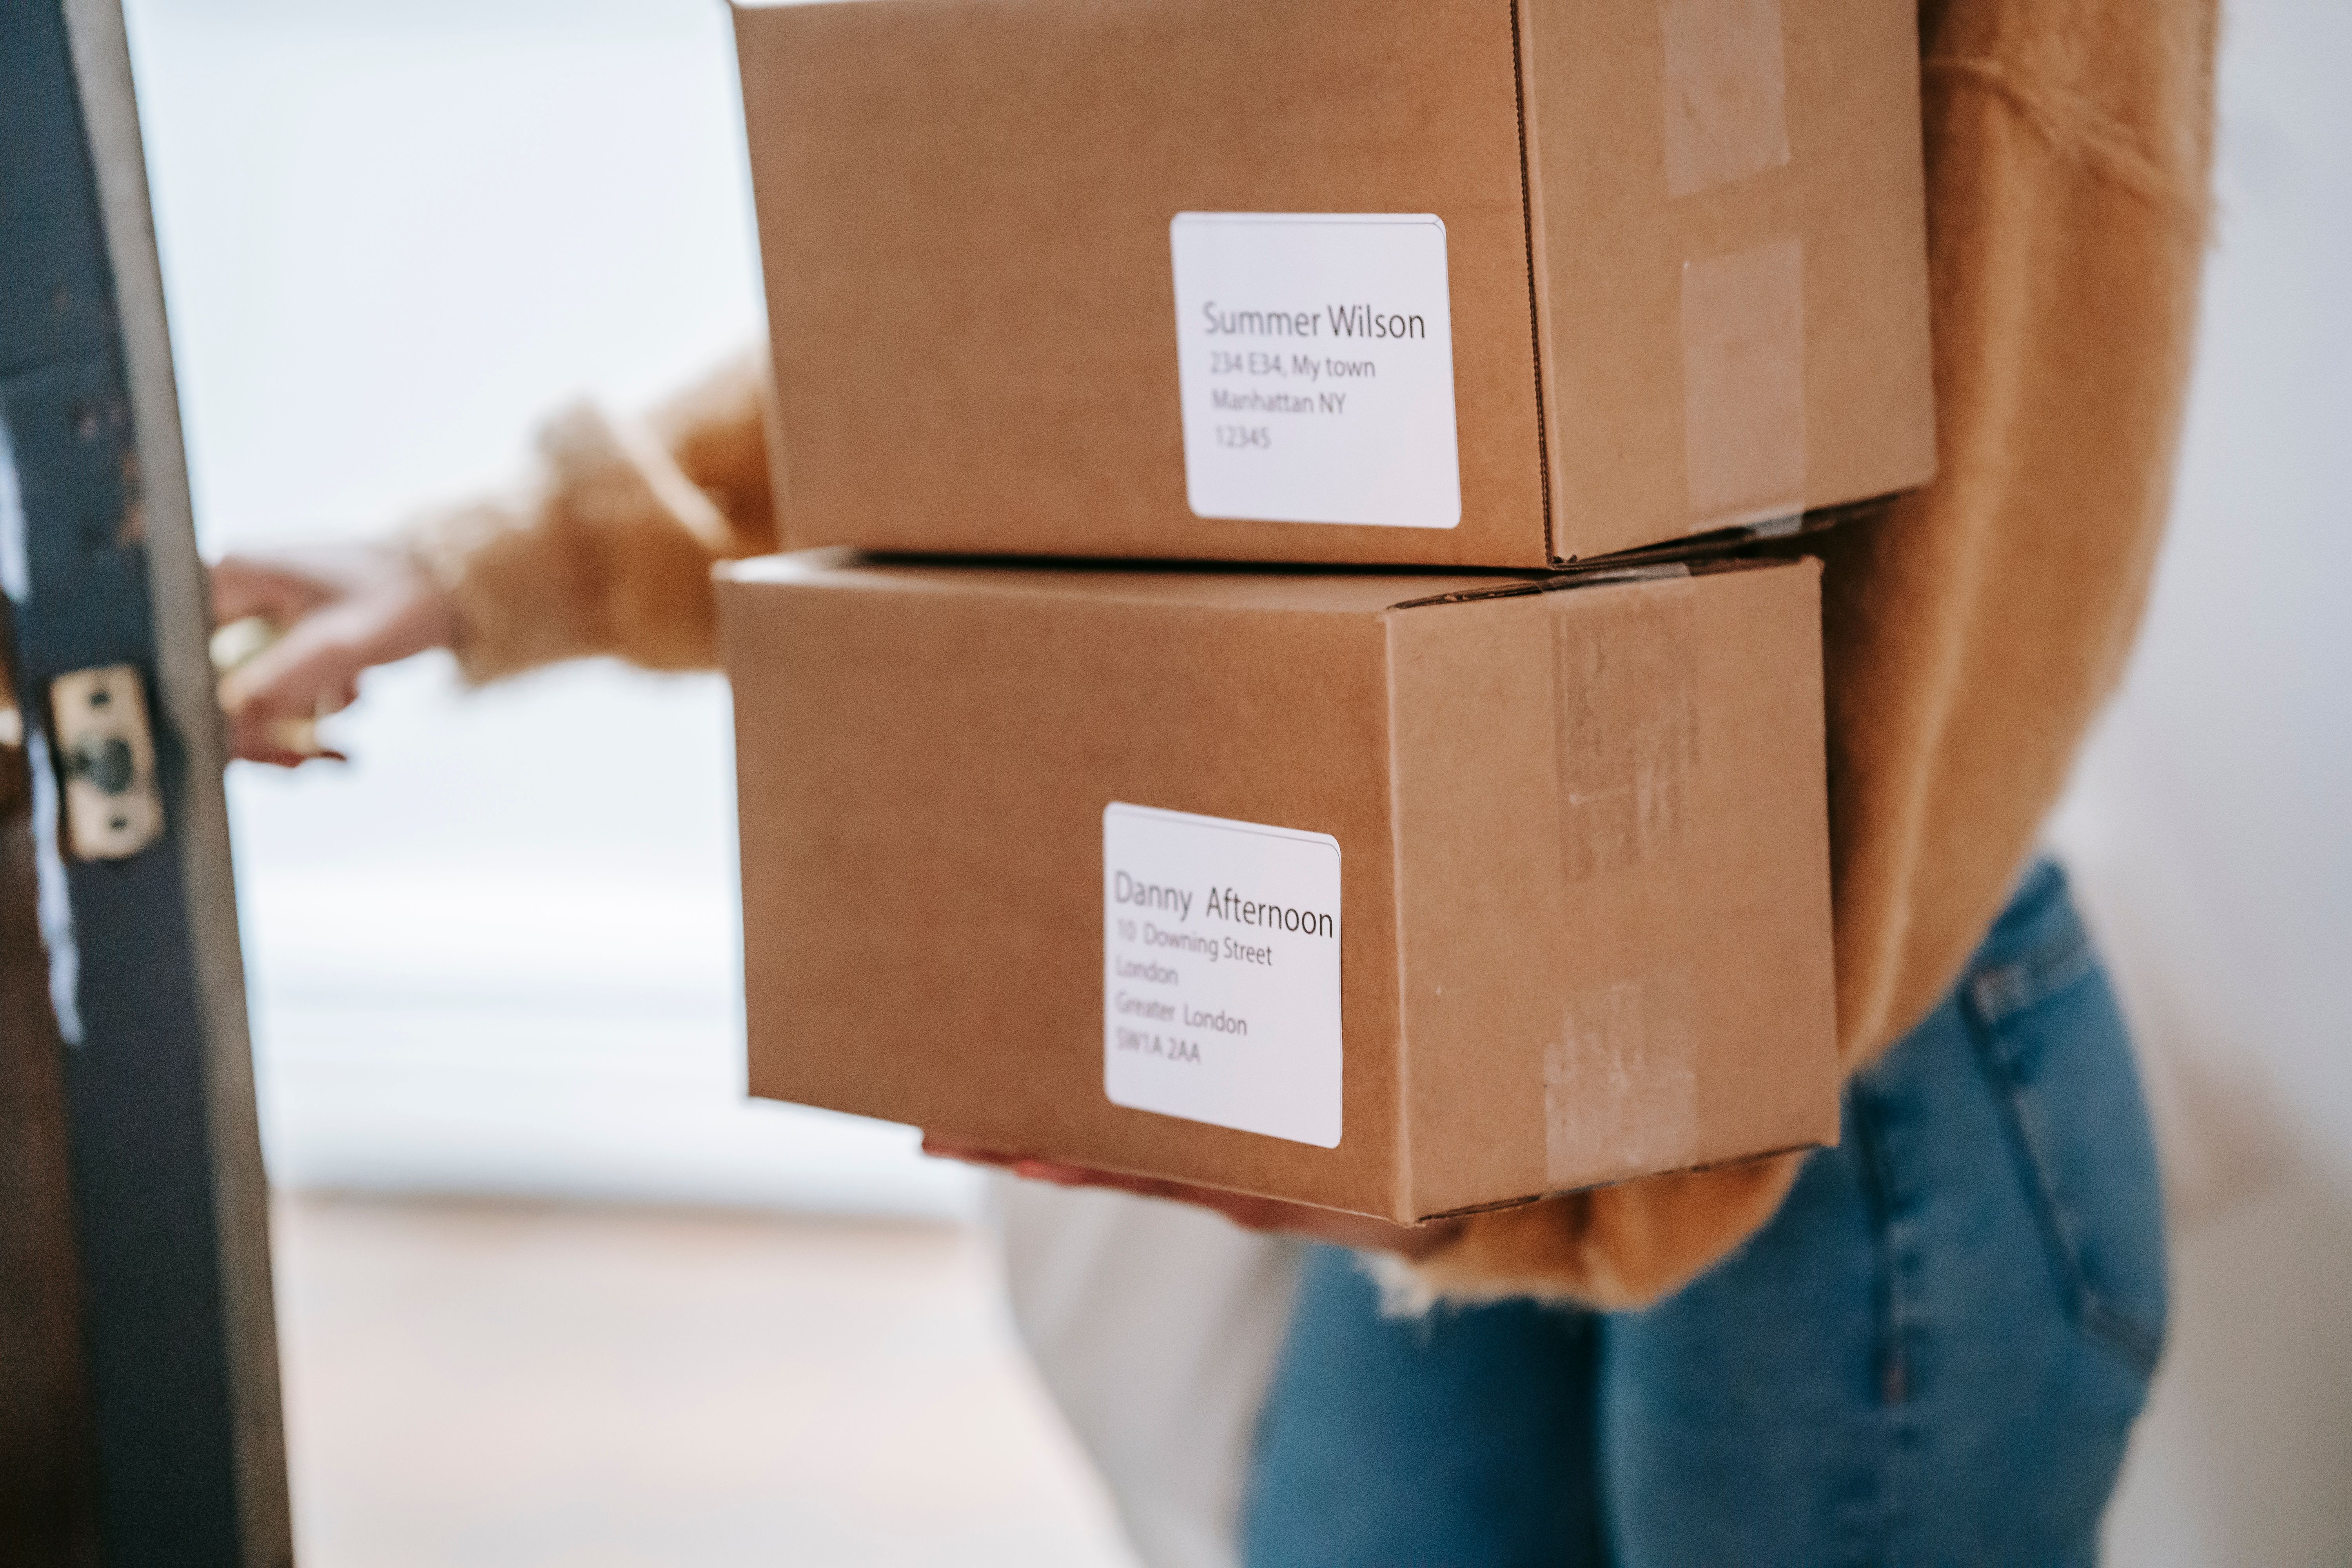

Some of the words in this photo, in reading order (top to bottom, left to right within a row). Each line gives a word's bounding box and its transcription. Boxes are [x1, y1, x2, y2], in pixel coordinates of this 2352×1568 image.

[1202, 300, 1321, 336] Summer
[1327, 303, 1425, 339] Wilson
[1210, 350, 1242, 375] 234
[1292, 354, 1320, 381] My
[1326, 357, 1376, 377] town
[1212, 388, 1314, 414] Manhattan
[1319, 392, 1347, 414] NY
[1216, 425, 1271, 449] 12345
[1114, 870, 1193, 922] Danny
[1206, 886, 1333, 938] Afternoon
[1117, 918, 1136, 941] 10
[1143, 922, 1218, 962] Downing
[1223, 936, 1272, 966] Street
[1115, 955, 1178, 985] London
[1114, 991, 1175, 1022] Greater
[1183, 1003, 1247, 1036] London
[1114, 1025, 1163, 1055] SW1A
[1168, 1037, 1201, 1063] 2AA
